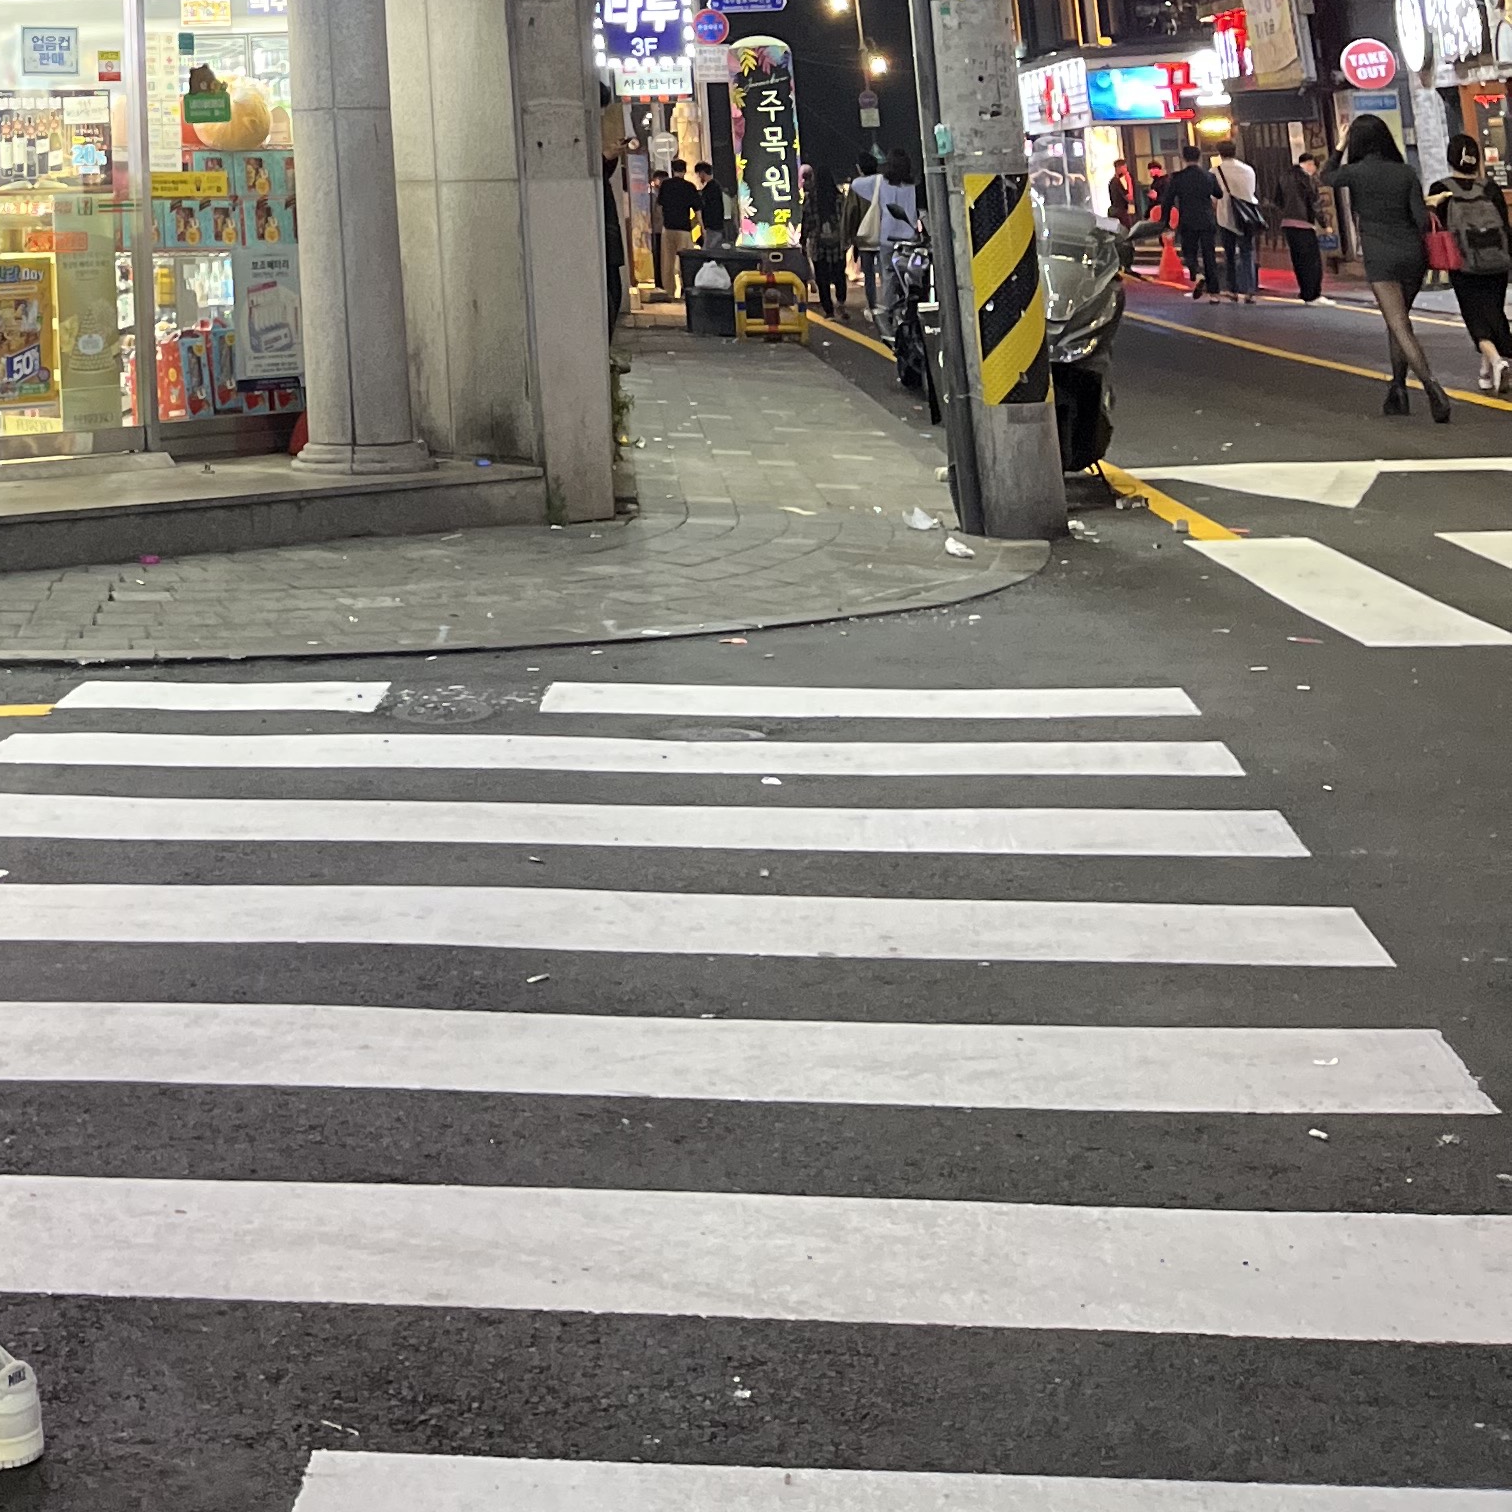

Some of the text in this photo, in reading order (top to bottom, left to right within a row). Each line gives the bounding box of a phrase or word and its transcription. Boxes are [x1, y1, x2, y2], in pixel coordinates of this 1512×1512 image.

[631, 37, 658, 57] 3F
[1348, 50, 1388, 67] TAKE
[1355, 66, 1387, 80] OUT
[756, 90, 792, 202] 주목원
